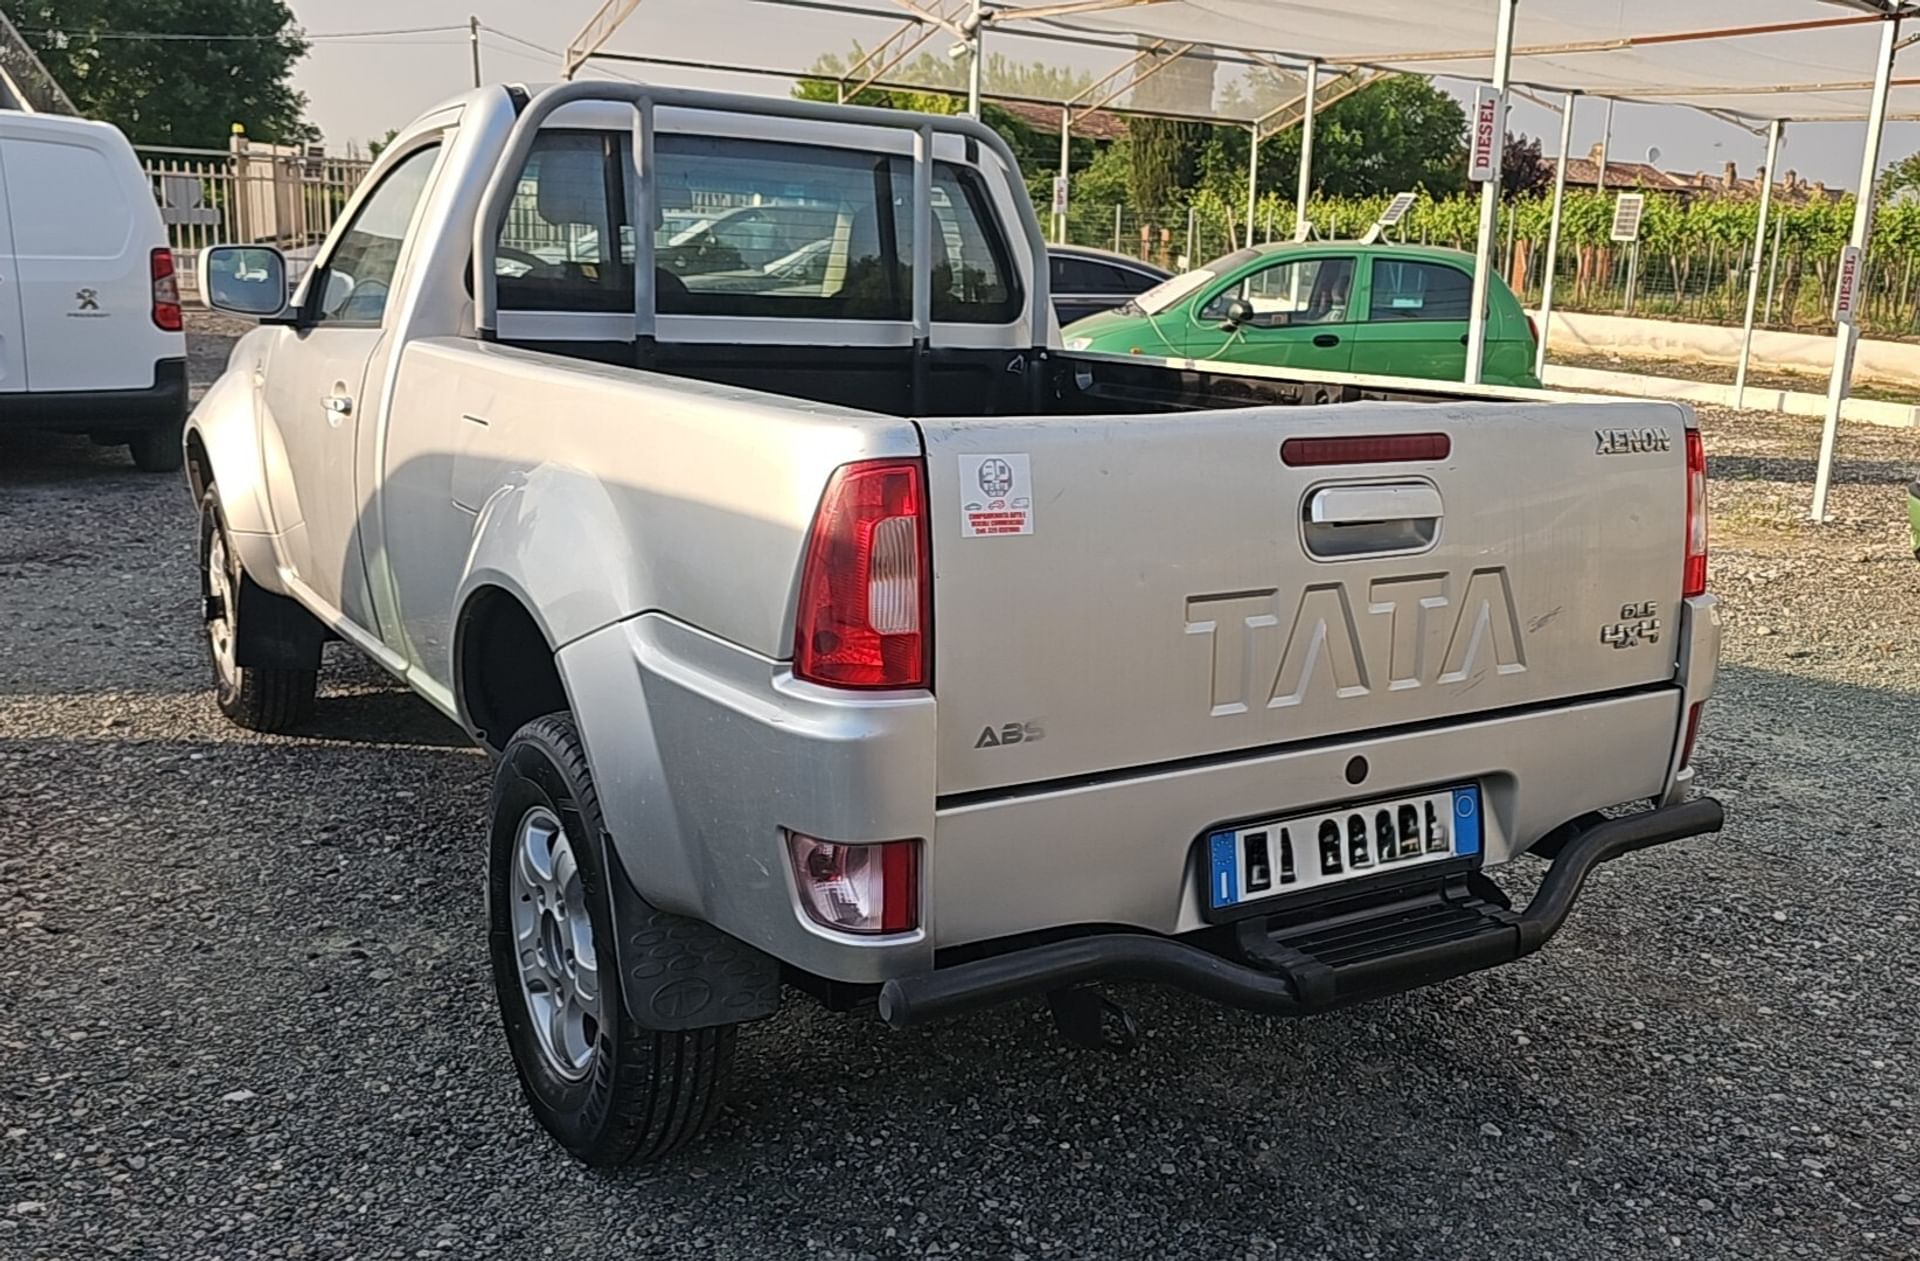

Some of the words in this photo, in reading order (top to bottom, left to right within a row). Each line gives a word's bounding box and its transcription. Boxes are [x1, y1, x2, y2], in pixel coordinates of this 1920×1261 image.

[1475, 99, 1495, 168] DIESEL
[1838, 254, 1856, 312] DIESEL
[1594, 428, 1670, 455] XENON
[1184, 566, 1528, 717] TATA
[974, 721, 1046, 749] ABS
